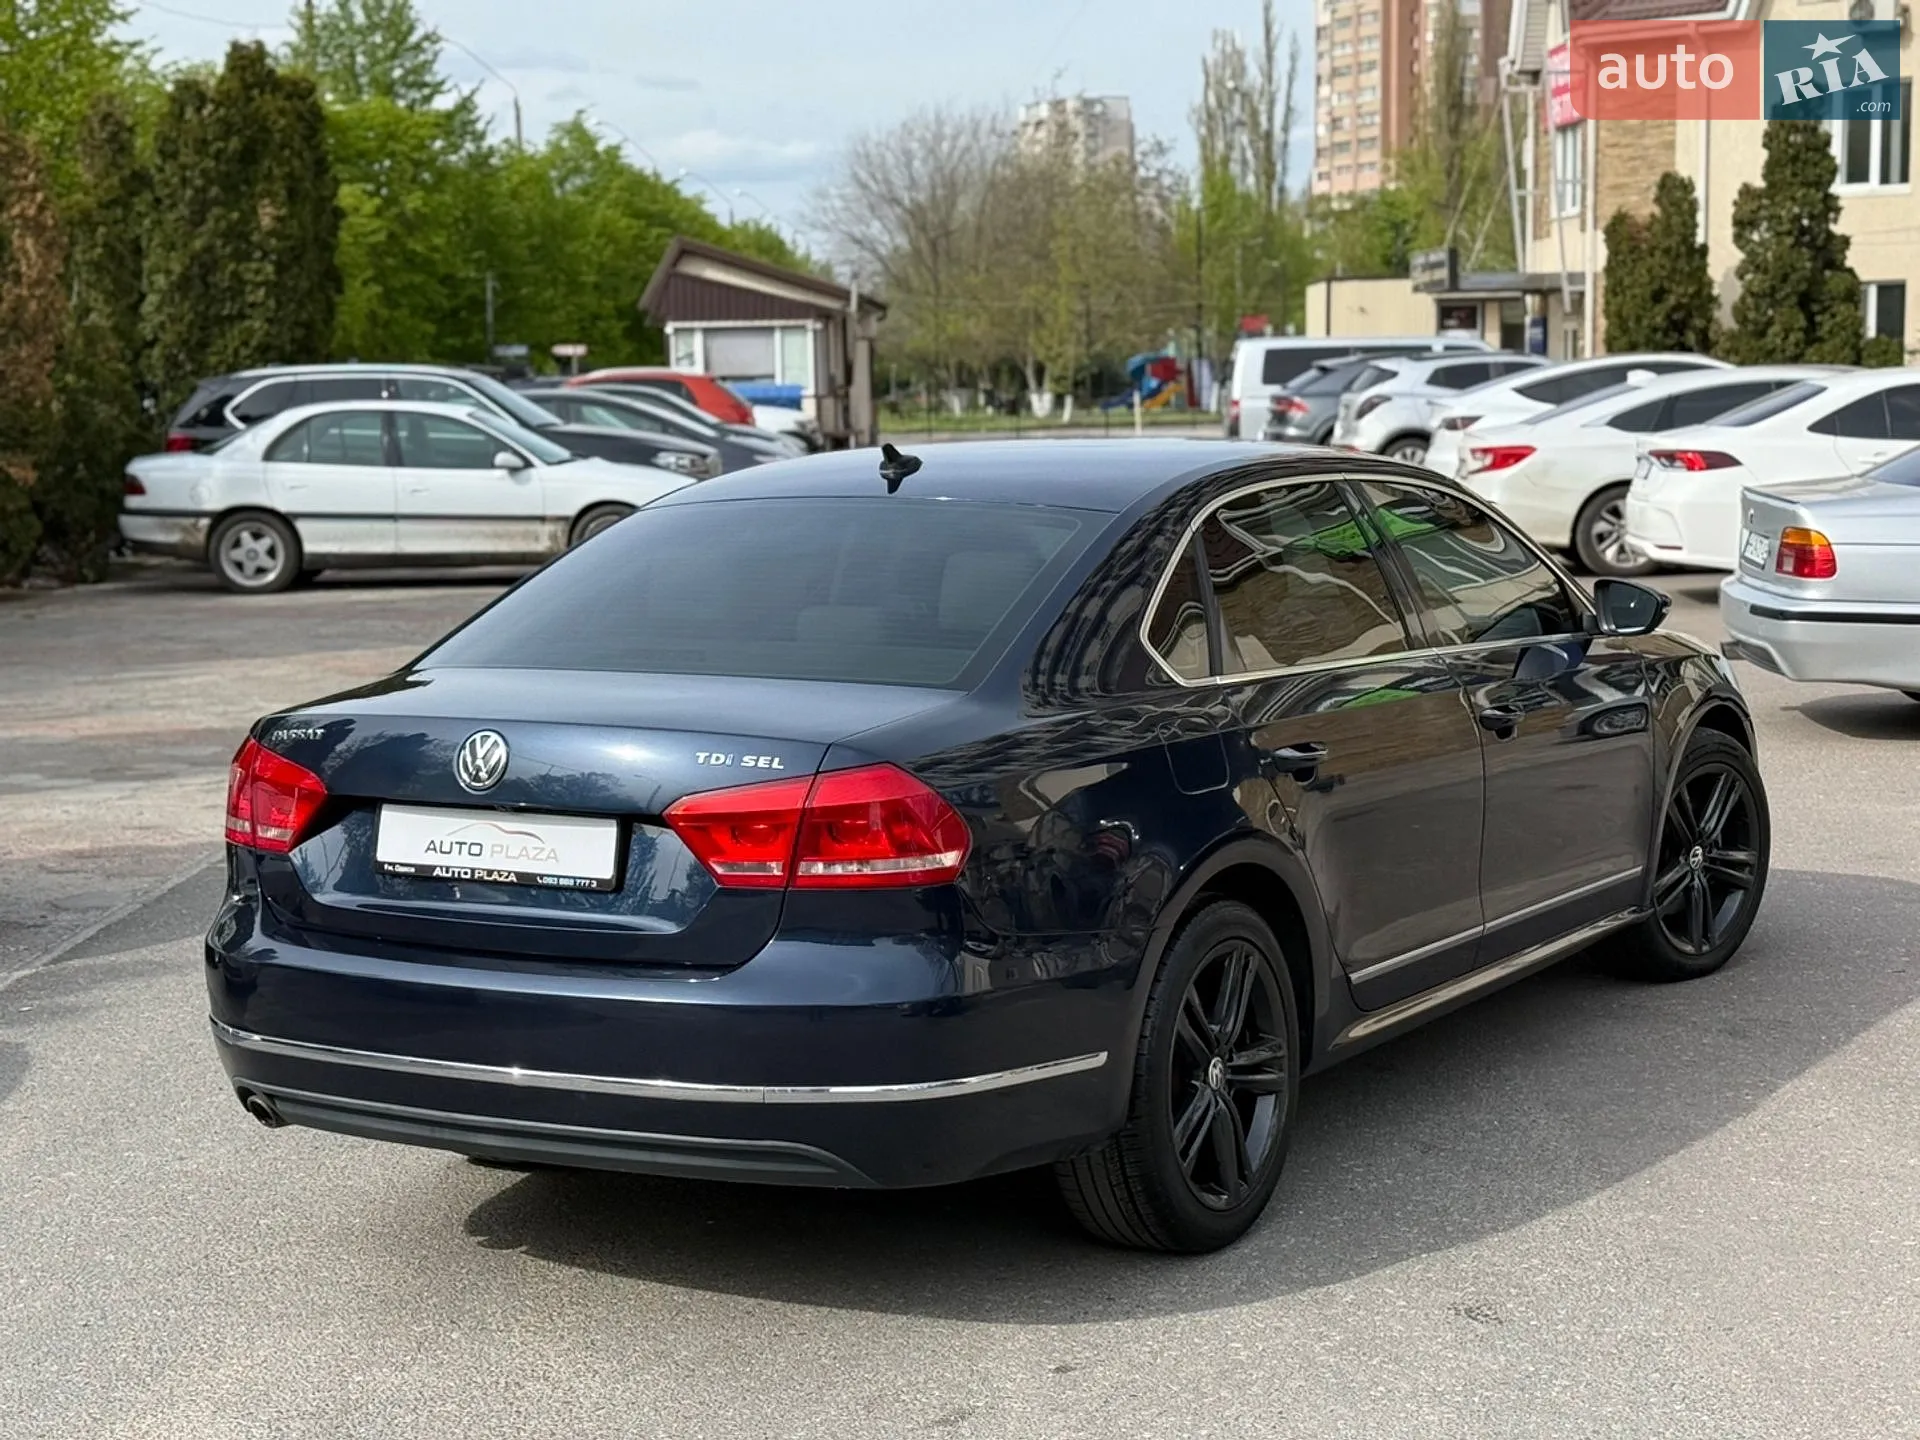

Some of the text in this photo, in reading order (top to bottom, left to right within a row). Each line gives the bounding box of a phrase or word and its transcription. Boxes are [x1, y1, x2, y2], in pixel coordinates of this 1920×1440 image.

[740, 754, 784, 769] SEL
[424, 839, 559, 862] AUTO PLAZA
[432, 866, 518, 883] AUTO PLAZA
